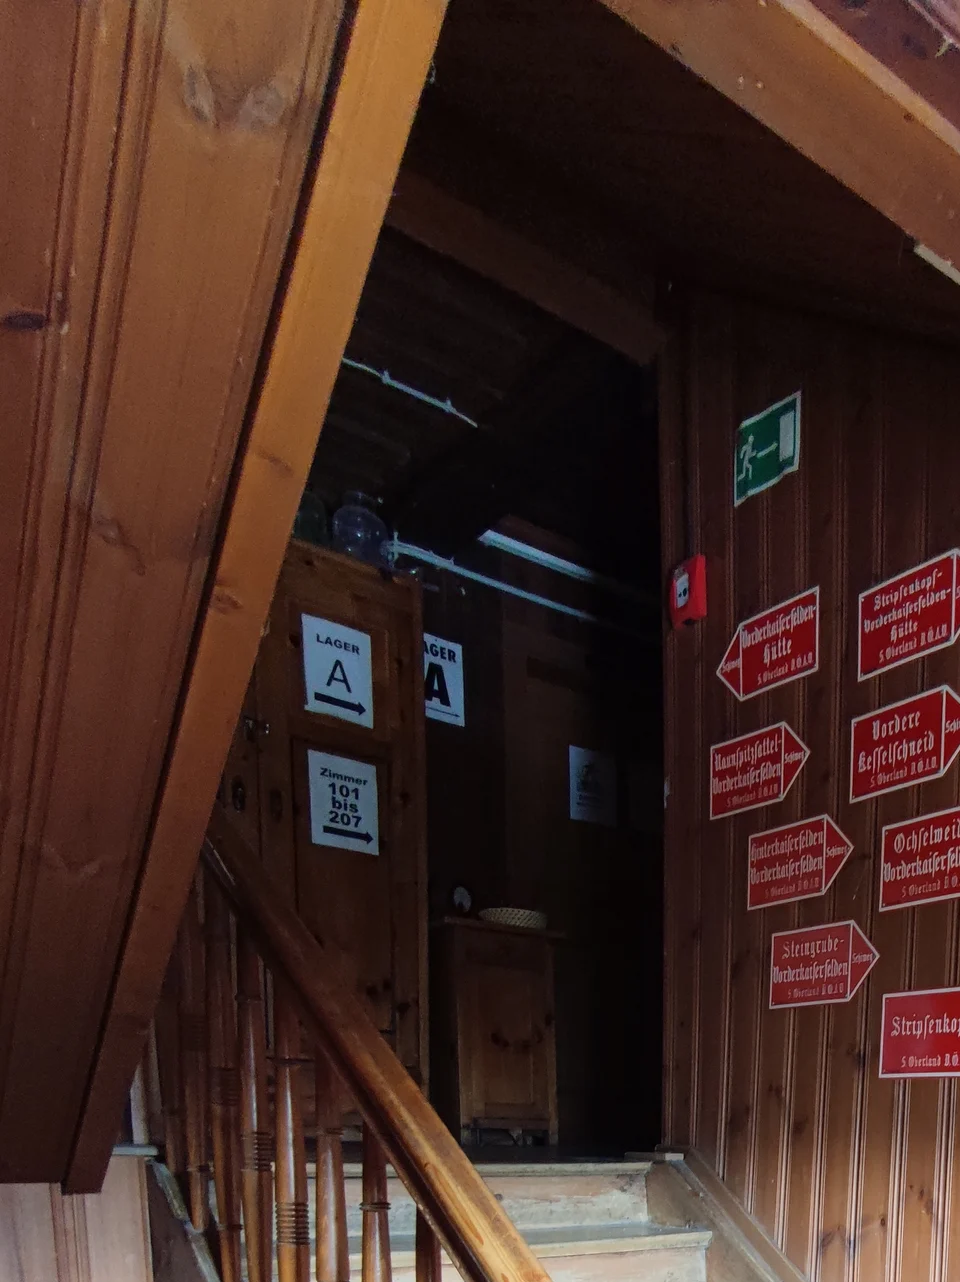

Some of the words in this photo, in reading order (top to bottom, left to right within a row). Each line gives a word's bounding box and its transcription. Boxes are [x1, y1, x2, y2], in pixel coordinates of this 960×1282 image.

[890, 620, 918, 642] Hütte
[316, 633, 360, 655] LAGER
[764, 637, 792, 667] Hütte
[885, 638, 917, 659] Oberland
[327, 659, 352, 693] A
[424, 662, 451, 708] A
[872, 711, 920, 740] Vordere
[320, 766, 368, 786] Zimmer
[877, 767, 908, 785] Oberland
[328, 782, 359, 800] 101
[332, 795, 359, 813] bis
[329, 810, 362, 828] 207
[908, 1054, 941, 1067] Oberland
